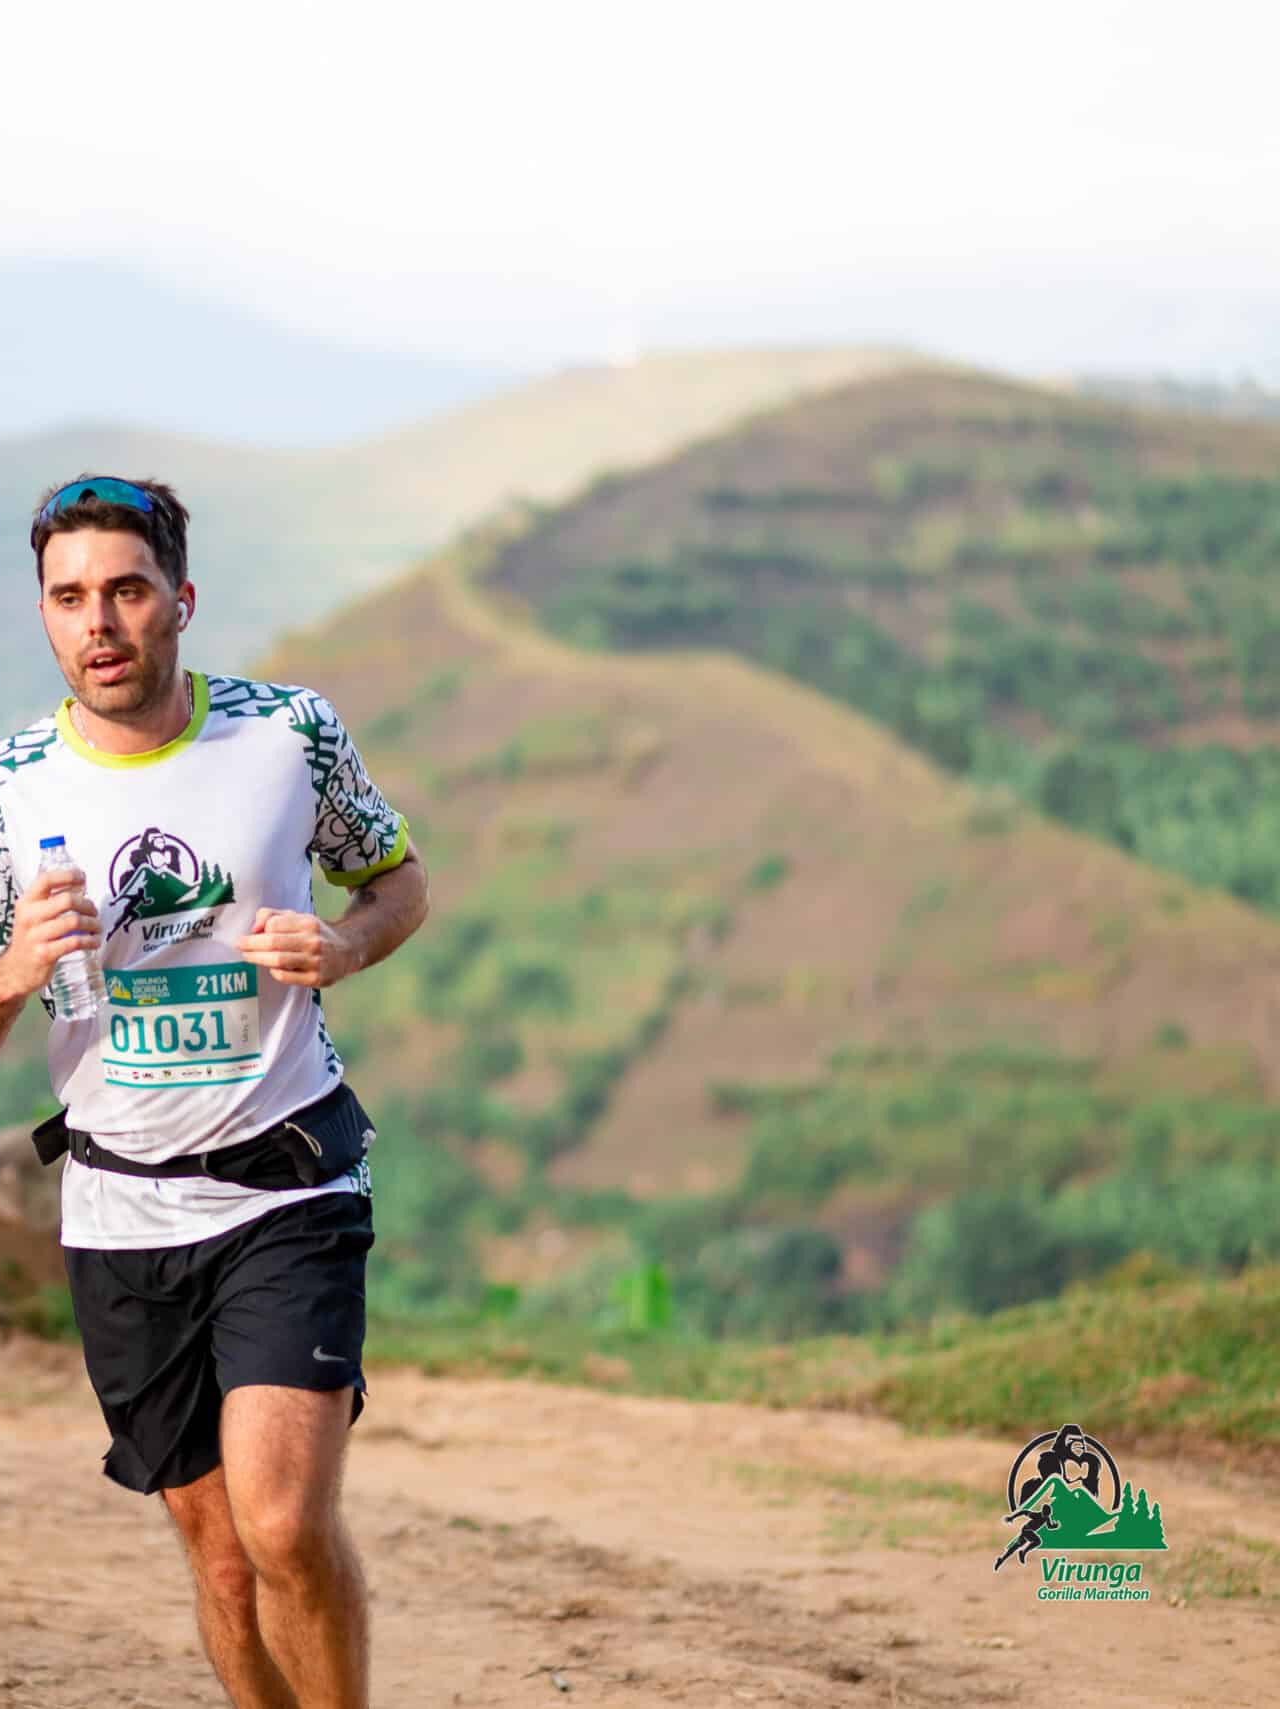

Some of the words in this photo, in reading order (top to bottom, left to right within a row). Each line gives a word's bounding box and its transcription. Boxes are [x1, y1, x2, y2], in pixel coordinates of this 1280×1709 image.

[142, 915, 214, 941] Virunga
[196, 972, 248, 996] 21KM
[110, 1009, 232, 1054] 01031
